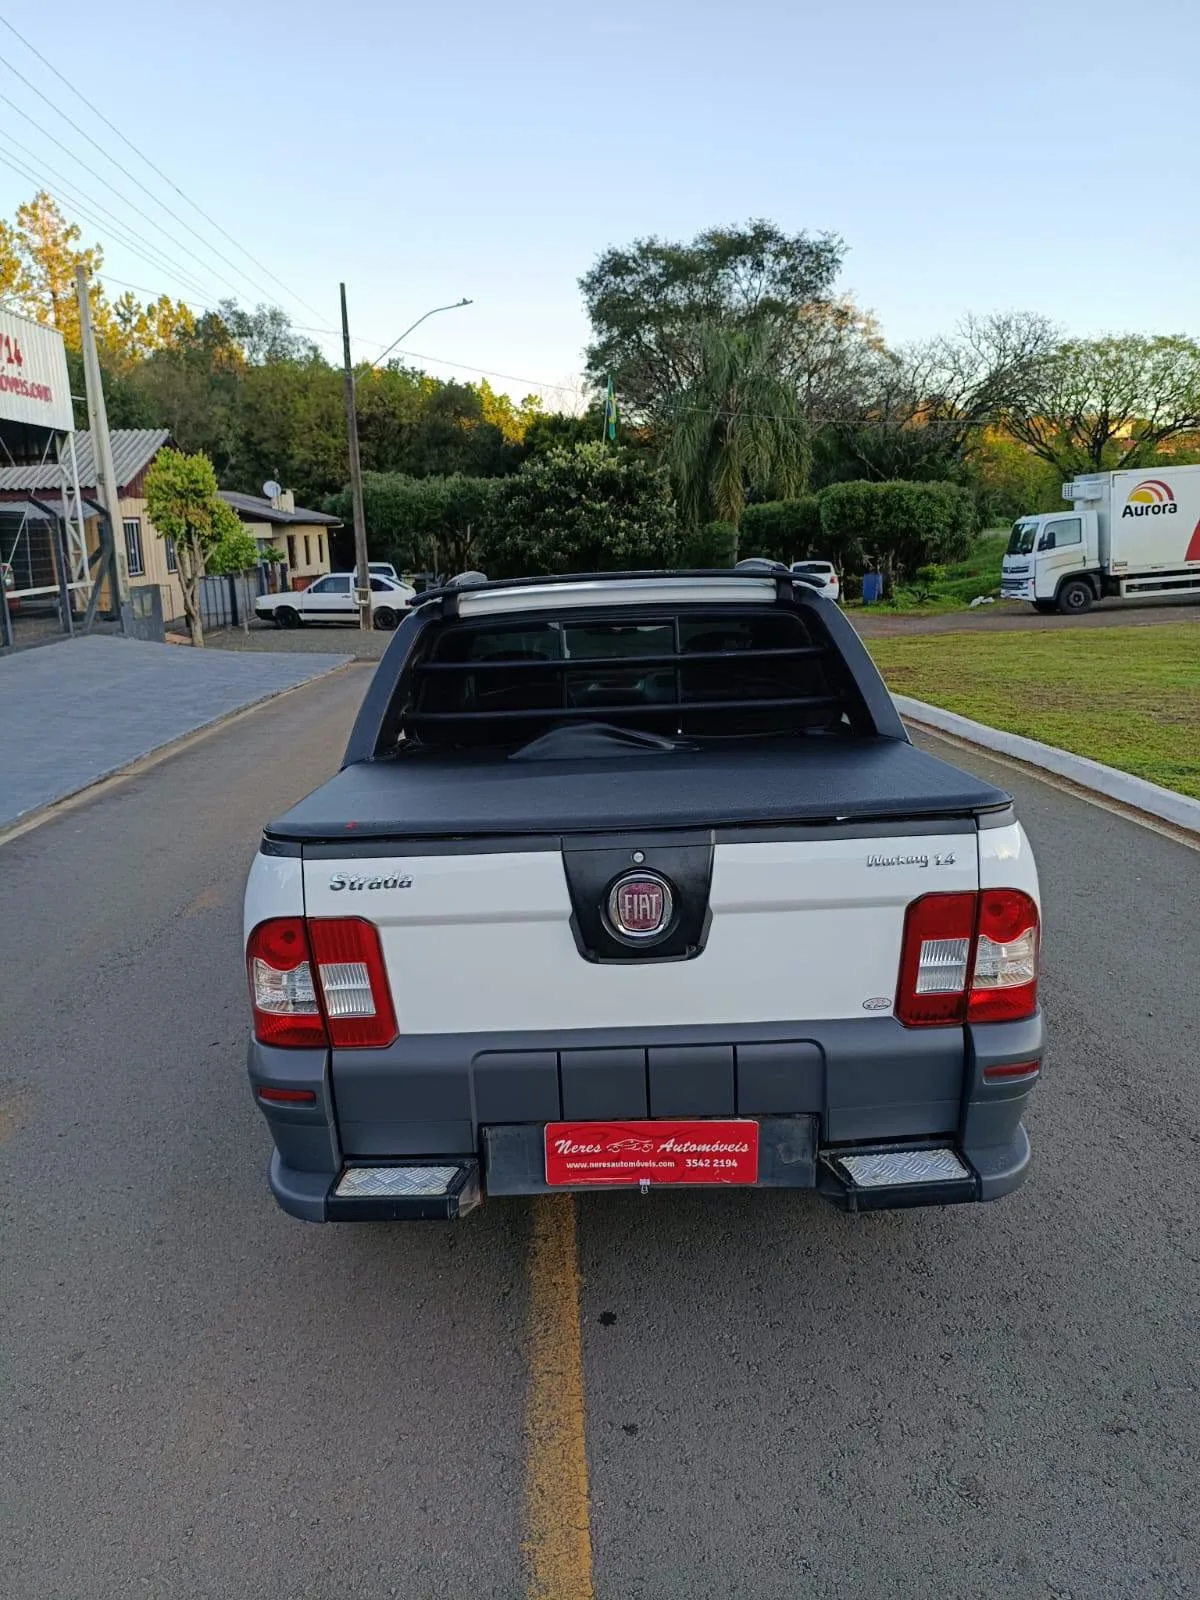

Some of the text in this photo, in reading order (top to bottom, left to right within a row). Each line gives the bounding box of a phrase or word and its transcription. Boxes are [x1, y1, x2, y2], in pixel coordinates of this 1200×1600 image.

[1122, 503, 1178, 518] Aurora
[866, 854, 929, 868] Working
[329, 871, 413, 891] Strada
[624, 894, 659, 920] FIAT
[555, 1138, 749, 1154] Neres Automóveis
[685, 1159, 711, 1168] 3542
[712, 1159, 738, 1168] 2194
